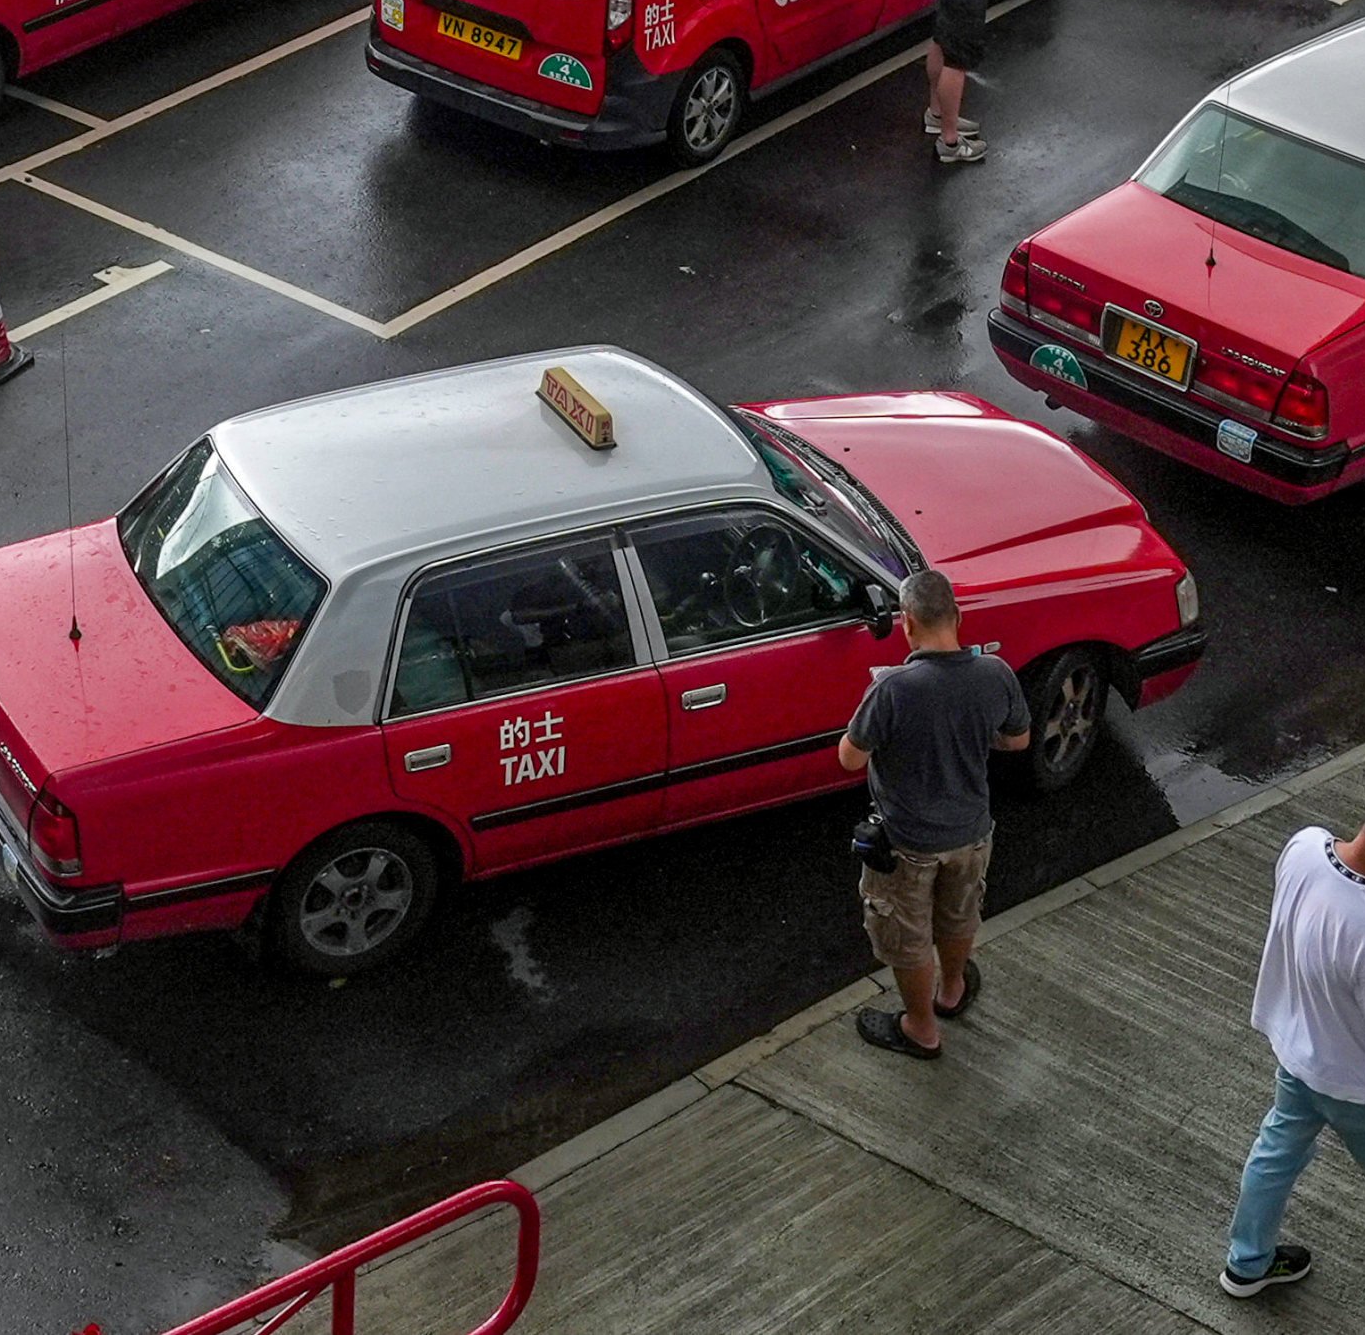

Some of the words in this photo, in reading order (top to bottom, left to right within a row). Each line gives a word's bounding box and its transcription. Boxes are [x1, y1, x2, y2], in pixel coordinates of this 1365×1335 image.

[644, 0, 673, 24] 的士
[441, 15, 463, 36] VN
[469, 28, 519, 57] 8947
[644, 22, 674, 50] TAXI
[553, 54, 579, 66] TAXI
[559, 64, 570, 76] 4
[547, 71, 582, 87] SEATS
[1137, 325, 1167, 356] AX
[1053, 358, 1064, 370] 4
[1126, 342, 1172, 375] 386
[545, 373, 594, 435] TAXI
[499, 712, 564, 751] 的士
[500, 745, 565, 787] TAXI
